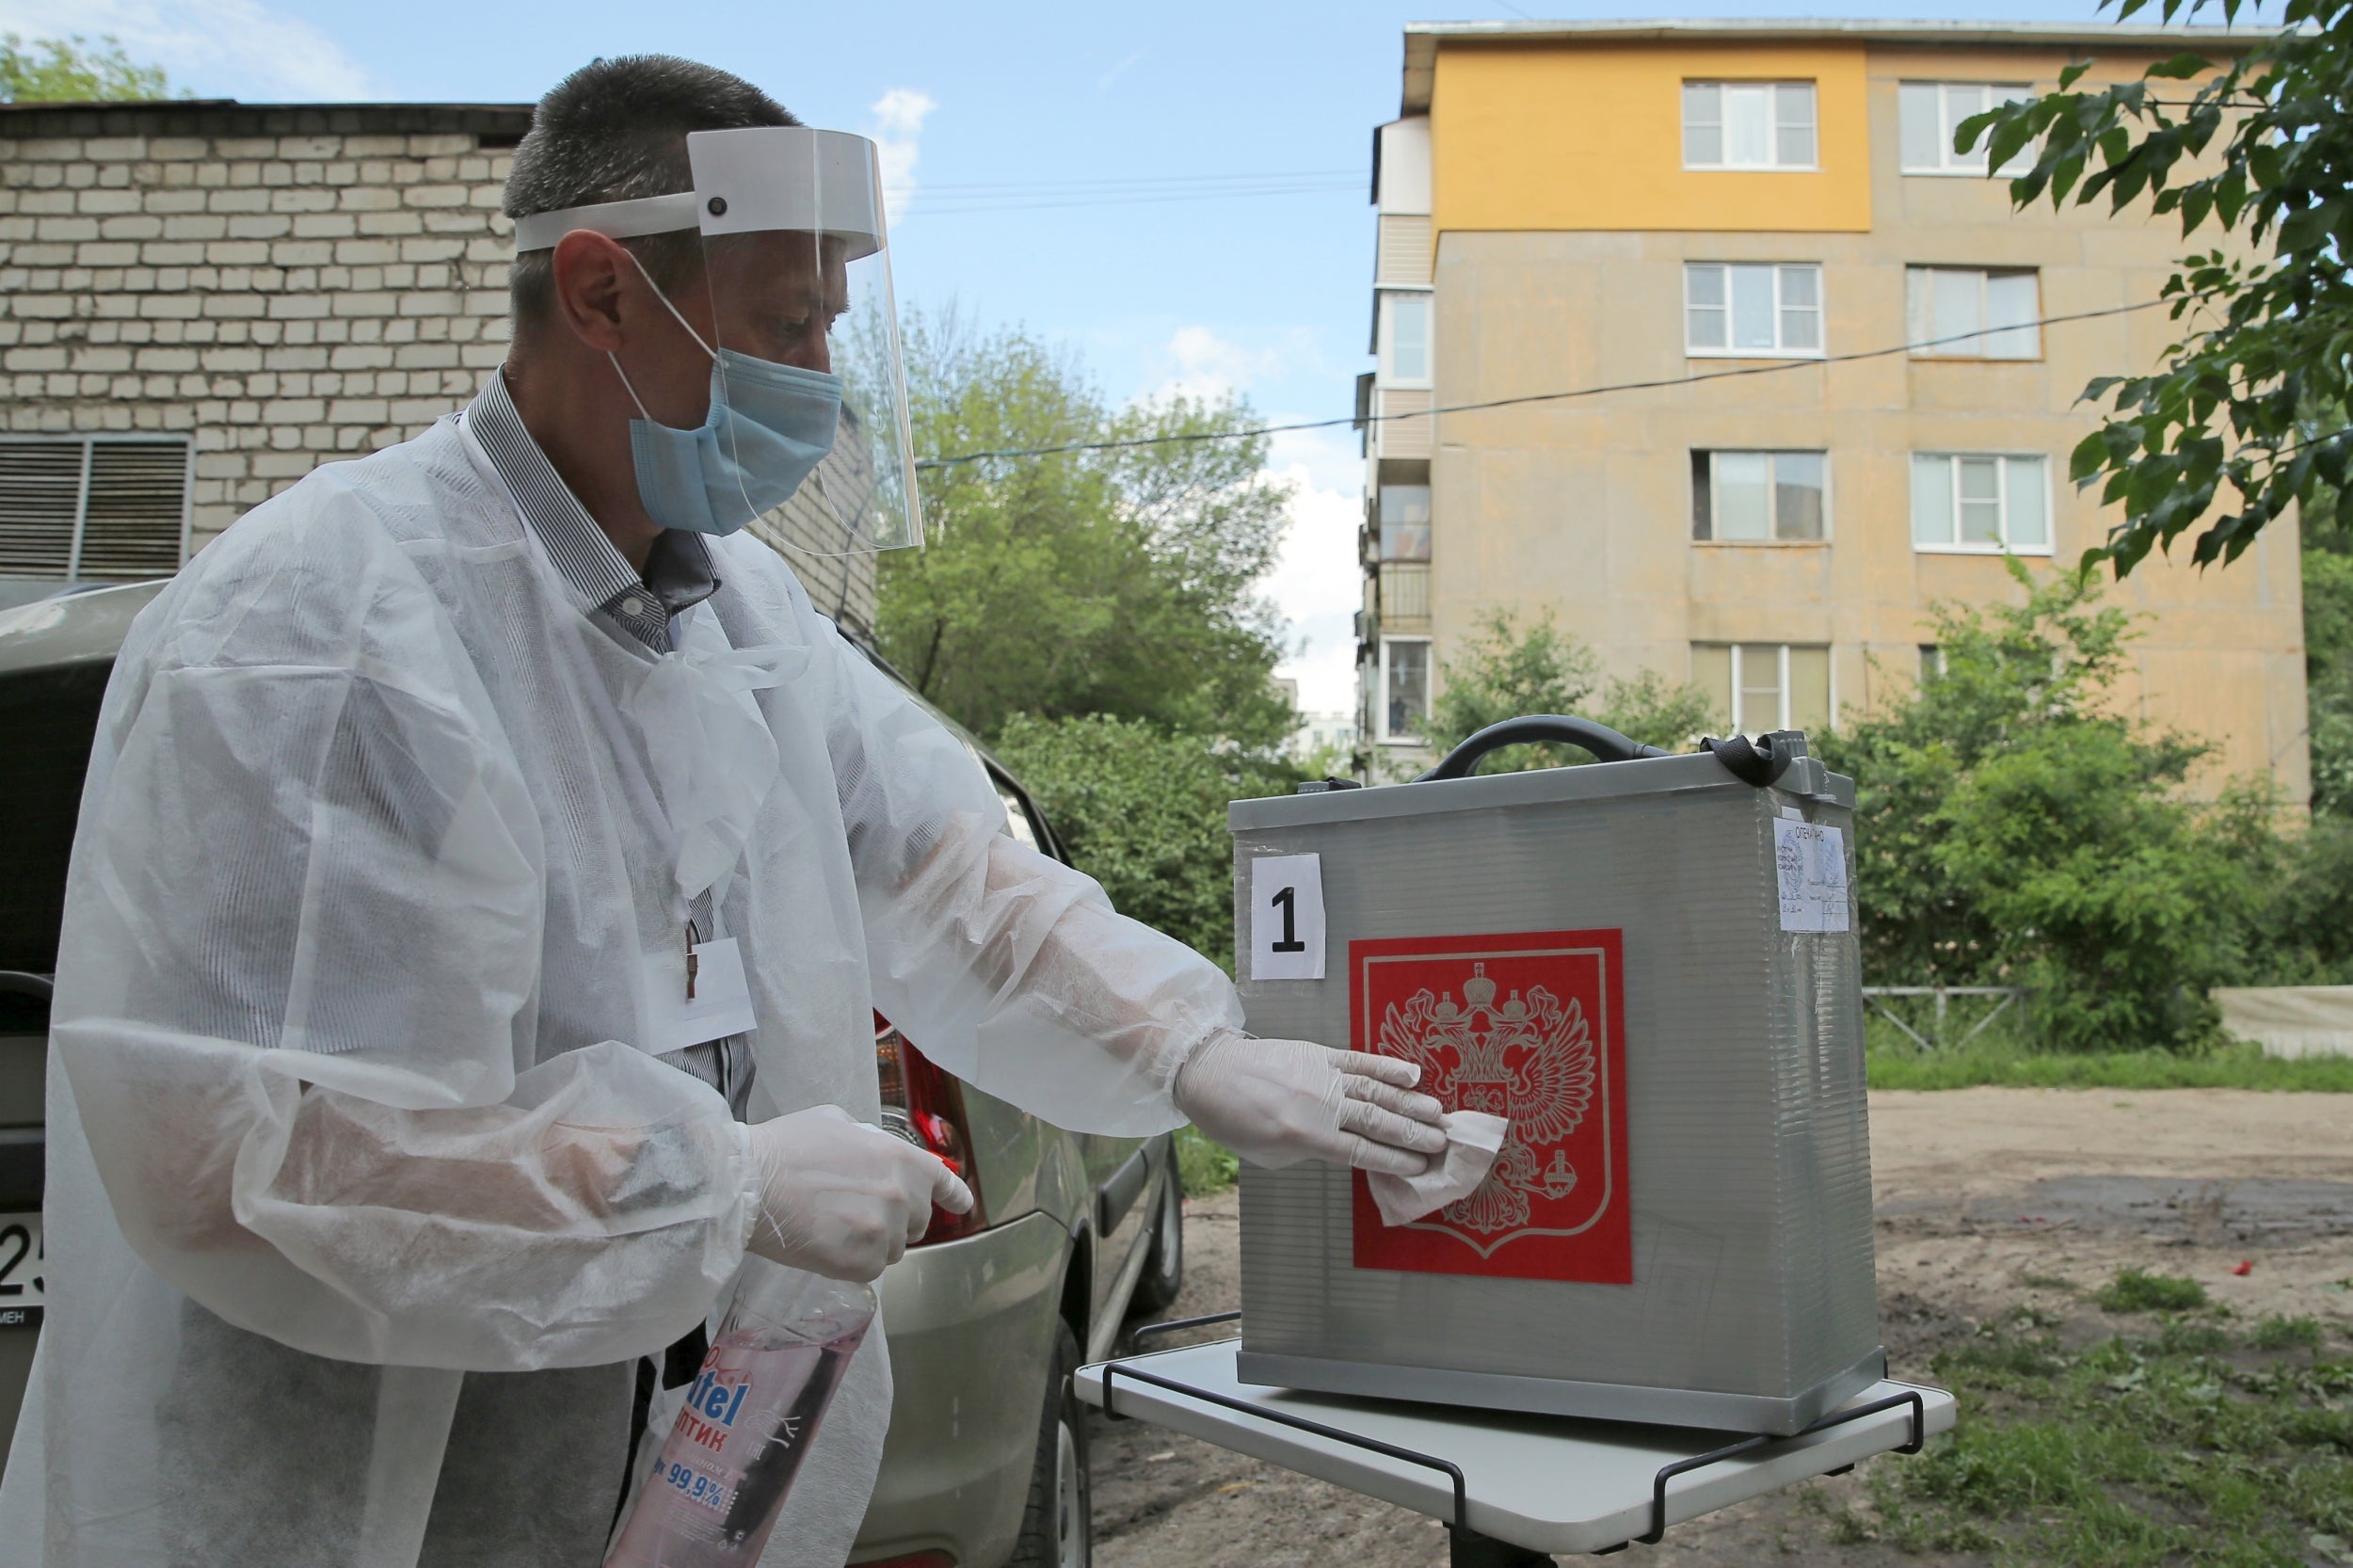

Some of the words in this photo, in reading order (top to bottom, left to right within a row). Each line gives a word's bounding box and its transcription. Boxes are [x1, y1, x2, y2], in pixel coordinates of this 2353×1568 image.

[1272, 887, 1305, 952] 1
[0, 1225, 44, 1295] 2
[674, 1411, 729, 1453] ПТИК
[667, 1464, 723, 1506] 99,9%
